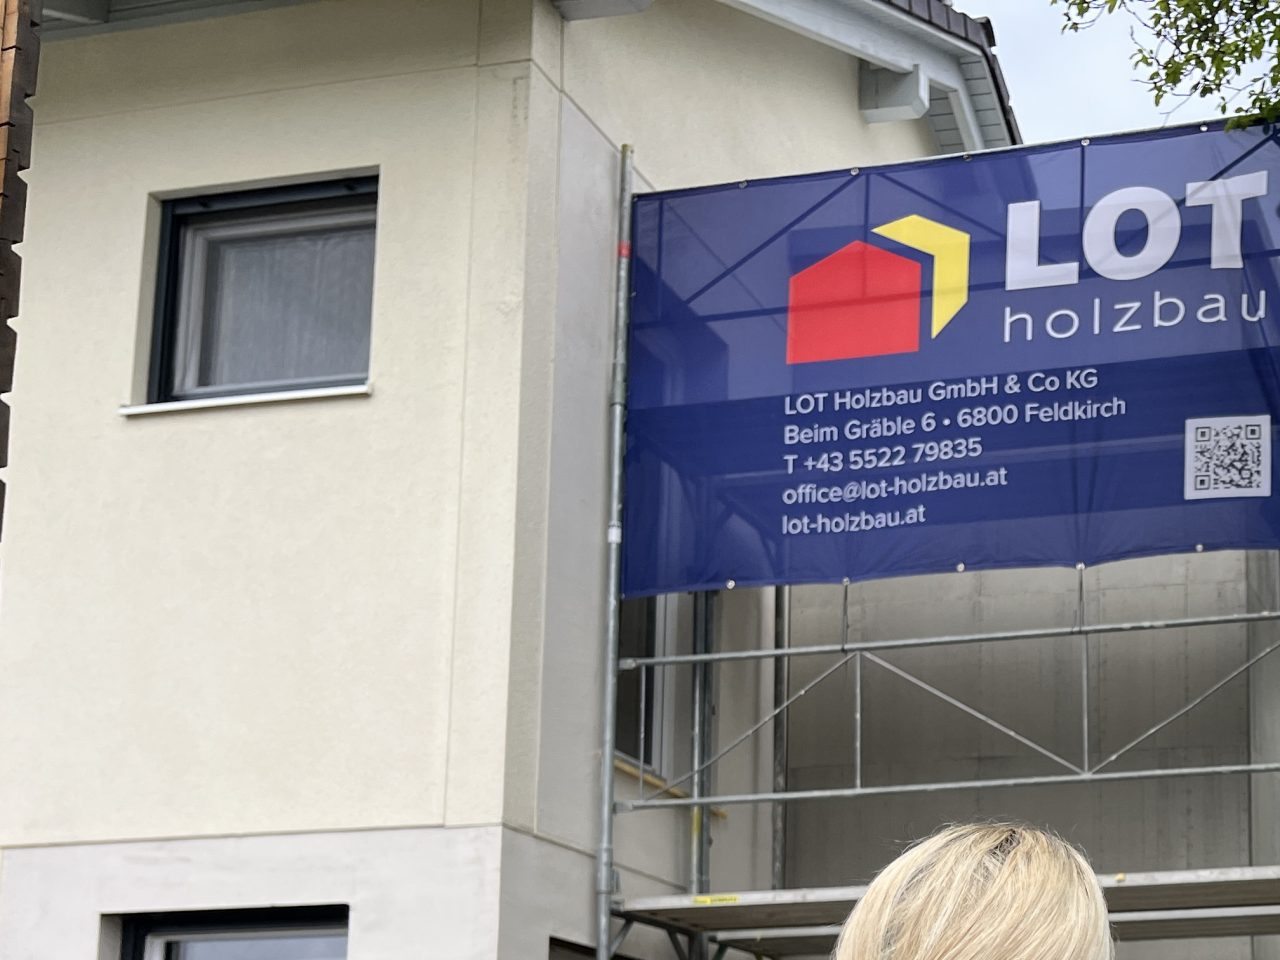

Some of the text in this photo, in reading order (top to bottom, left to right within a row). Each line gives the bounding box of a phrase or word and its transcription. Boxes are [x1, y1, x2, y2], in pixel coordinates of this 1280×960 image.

[1005, 170, 1268, 291] LOT
[1003, 290, 1266, 342] holzbau
[784, 368, 1098, 415] LOT Holzbau GmbH & Co KG
[784, 424, 839, 445] Beim
[844, 416, 916, 440] Gräble
[921, 412, 936, 431] 6
[957, 404, 1018, 428] 6800
[1025, 396, 1126, 423] Feldkirch
[783, 437, 983, 474] T +43 5522 79835
[782, 467, 1008, 504] office@lot-holzbau.at
[782, 504, 926, 534] lot-holzbau.at
